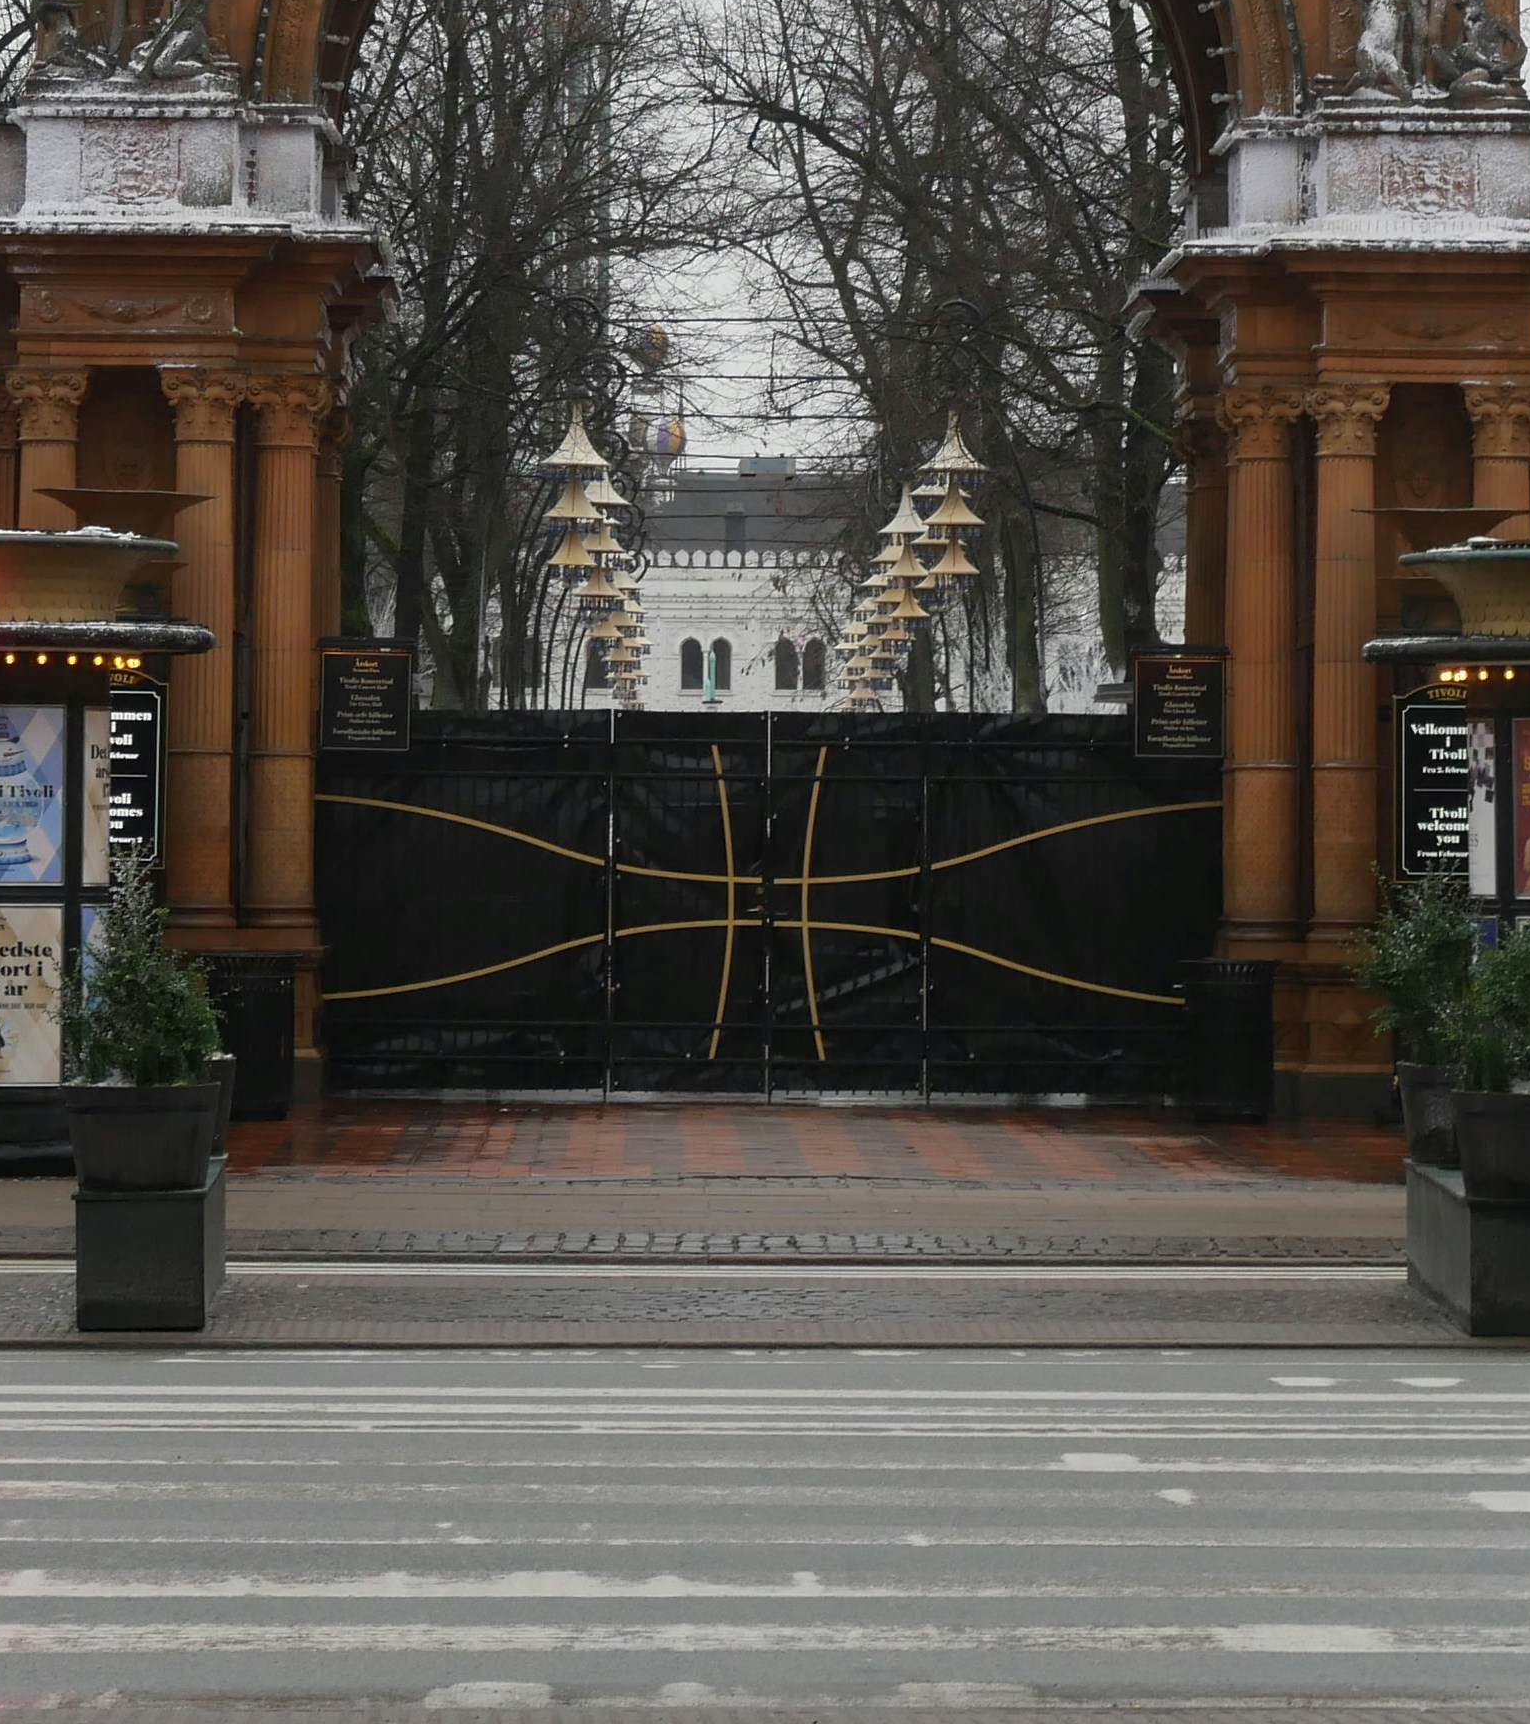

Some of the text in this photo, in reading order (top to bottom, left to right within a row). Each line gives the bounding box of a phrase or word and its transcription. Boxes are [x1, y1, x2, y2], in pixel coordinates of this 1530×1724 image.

[1427, 689, 1467, 700] TIVOLI
[1410, 723, 1469, 736] Velkomm
[1445, 736, 1452, 748] i
[1428, 749, 1467, 760] Tivoli
[7, 785, 53, 798] Tivoli
[1428, 807, 1467, 819] Tivoli
[1436, 833, 1460, 846] you
[1438, 850, 1469, 858] Februar
[37, 961, 44, 977] i
[4, 979, 28, 997] år
